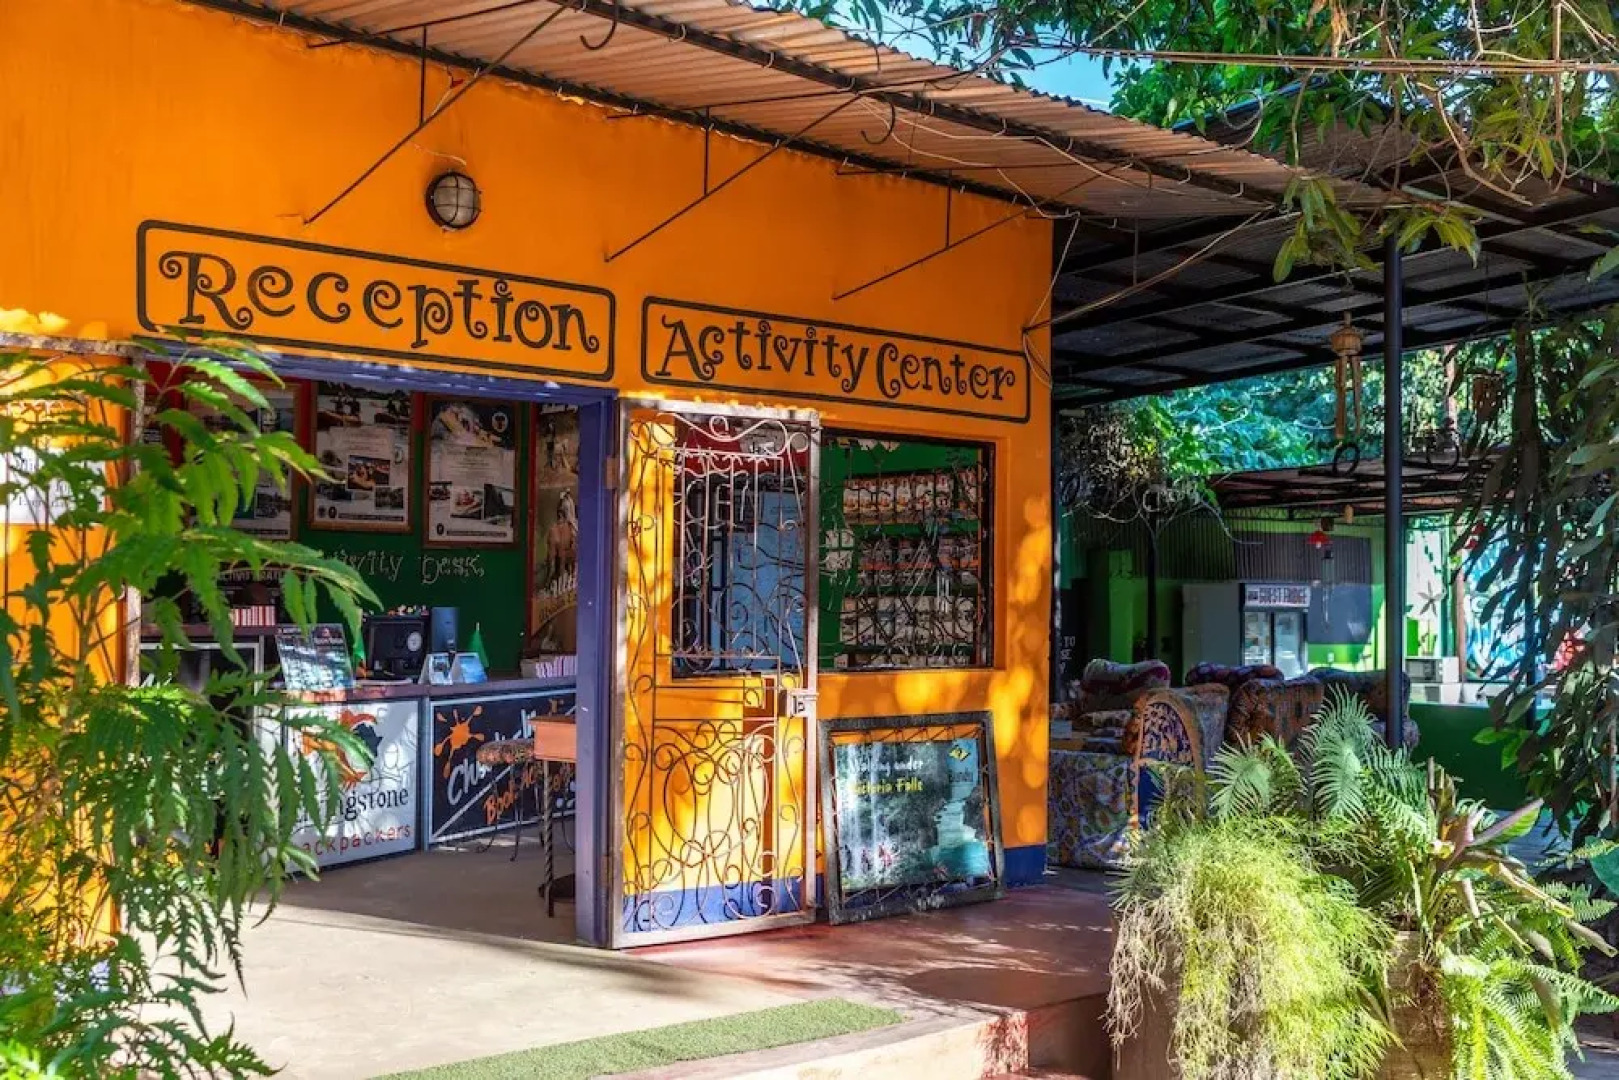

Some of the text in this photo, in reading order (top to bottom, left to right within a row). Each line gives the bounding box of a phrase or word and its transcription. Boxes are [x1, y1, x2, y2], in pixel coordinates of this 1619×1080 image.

[158, 250, 600, 354] Reception
[655, 313, 1016, 401] Activity Center
[895, 776, 923, 793] Falls
[302, 823, 411, 856] ackpackers
